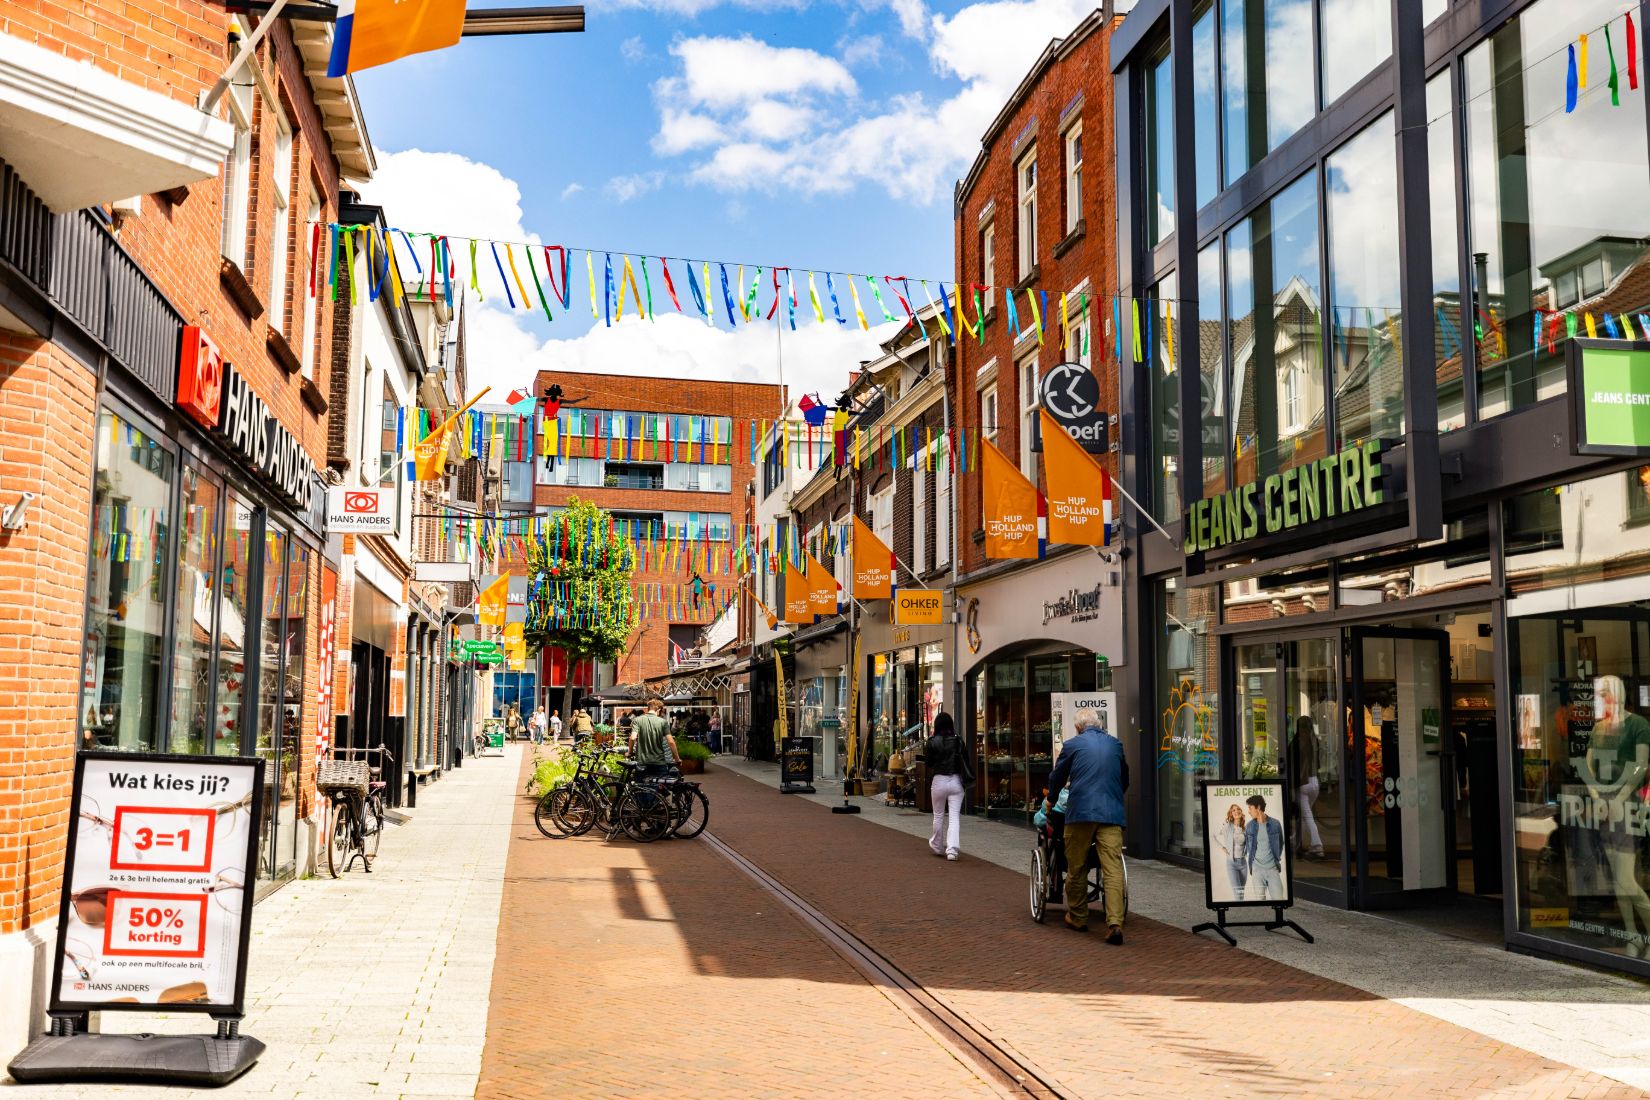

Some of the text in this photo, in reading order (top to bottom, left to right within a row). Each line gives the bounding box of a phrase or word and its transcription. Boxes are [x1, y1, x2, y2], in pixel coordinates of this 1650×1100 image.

[1592, 392, 1650, 405] JEANS CENT
[224, 363, 315, 512] HANS ANDERS
[1068, 496, 1086, 505] HUP
[1184, 438, 1383, 554] JEANS CENTRE
[1057, 506, 1100, 516] HOLLAND
[356, 516, 390, 524] ANDERS
[1070, 516, 1088, 524] HUP
[992, 524, 1034, 532] HOLLAND
[901, 599, 939, 609] OHKER
[109, 773, 230, 795] Wat kies jij?
[1214, 788, 1274, 796] JEANS CENTRE
[134, 827, 190, 852] 3=1
[129, 907, 184, 928] 50%
[1568, 920, 1584, 930] JEANS
[1585, 924, 1605, 934] CENTRE
[128, 931, 182, 946] korting
